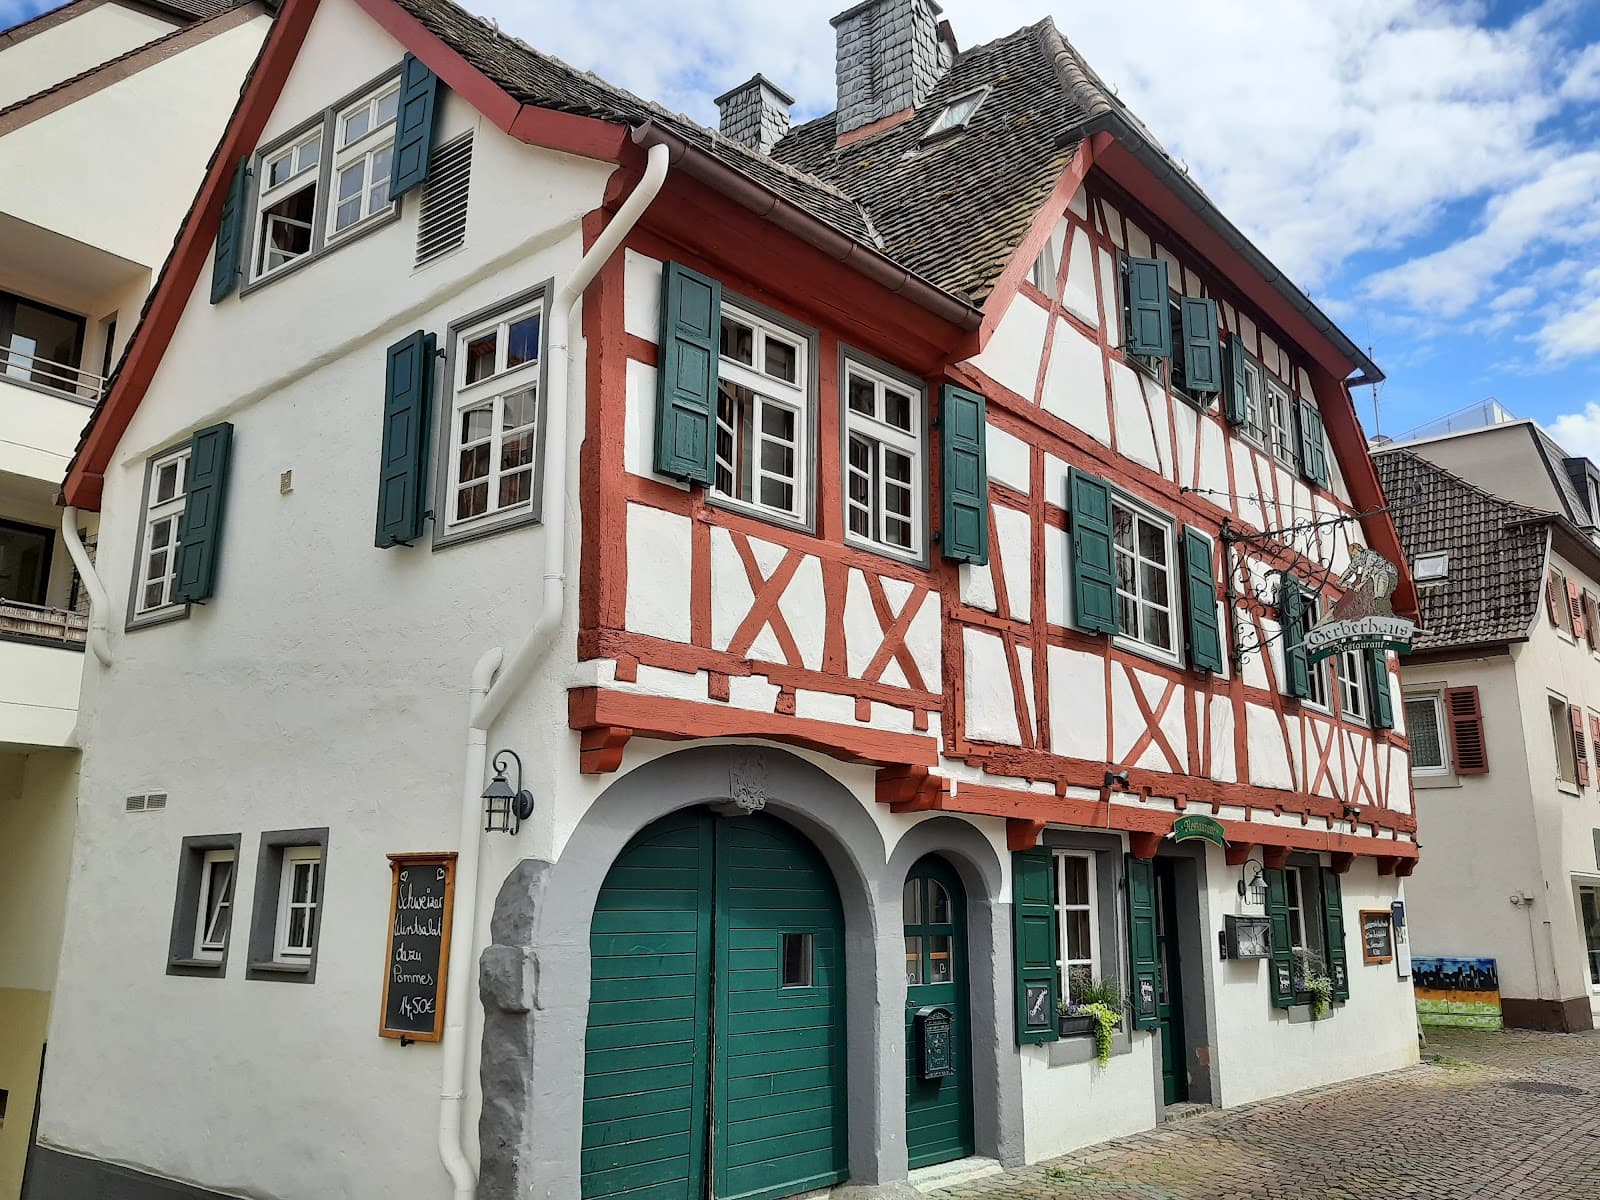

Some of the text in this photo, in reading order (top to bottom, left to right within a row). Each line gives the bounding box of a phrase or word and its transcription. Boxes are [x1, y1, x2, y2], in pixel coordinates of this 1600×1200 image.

[1308, 618, 1409, 645] Gerberhaus
[1334, 641, 1384, 653] Restaurant
[398, 883, 444, 910] Schweizer
[394, 913, 442, 937] Wurstsalat
[396, 942, 422, 962] dazu
[393, 964, 434, 986] Pommes
[399, 996, 436, 1021] 14,50€
